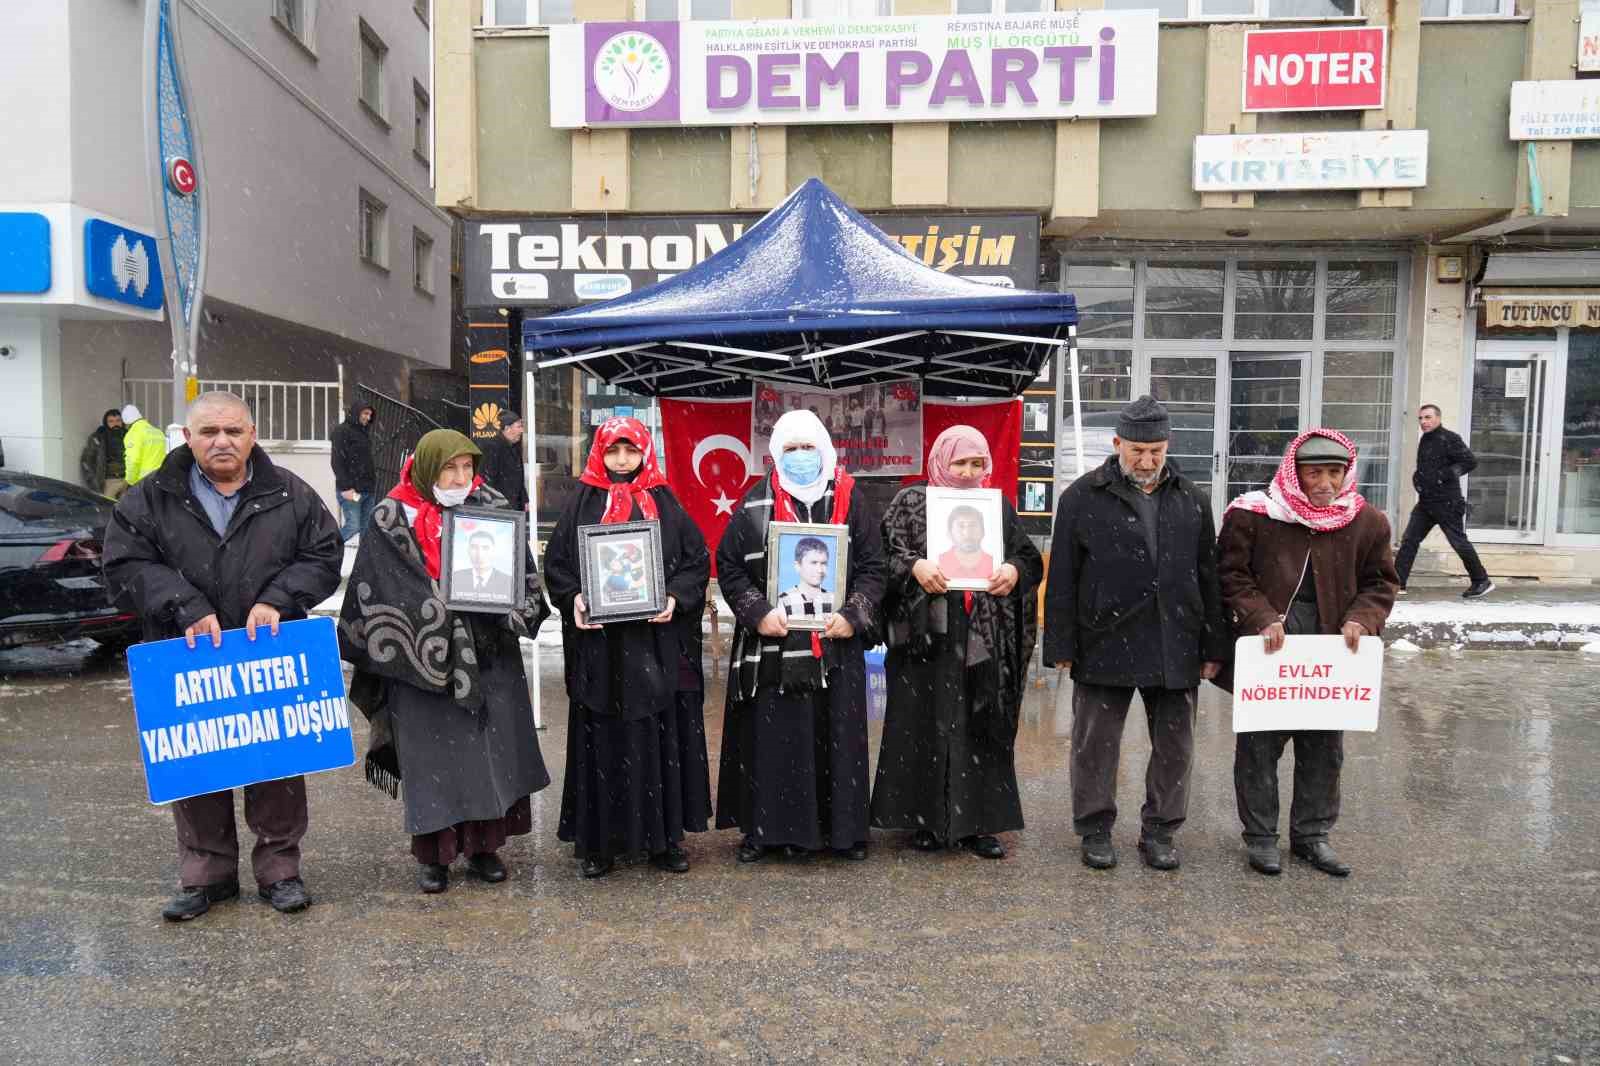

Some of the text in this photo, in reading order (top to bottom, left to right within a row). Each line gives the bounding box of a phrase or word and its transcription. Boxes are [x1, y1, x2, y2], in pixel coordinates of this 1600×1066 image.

[804, 40, 816, 50] VE
[706, 26, 1116, 110] DEM PARTİ
[1252, 52, 1376, 87] NOTER
[1502, 301, 1572, 321] TÜTÜNCÜ
[174, 652, 310, 708] ARTIK YETER !
[1278, 664, 1333, 678] EVLAT
[1241, 683, 1372, 701] NÖBETİNDEYİZ
[142, 690, 350, 764] YAKAMIZDAN DÜŞÜN
